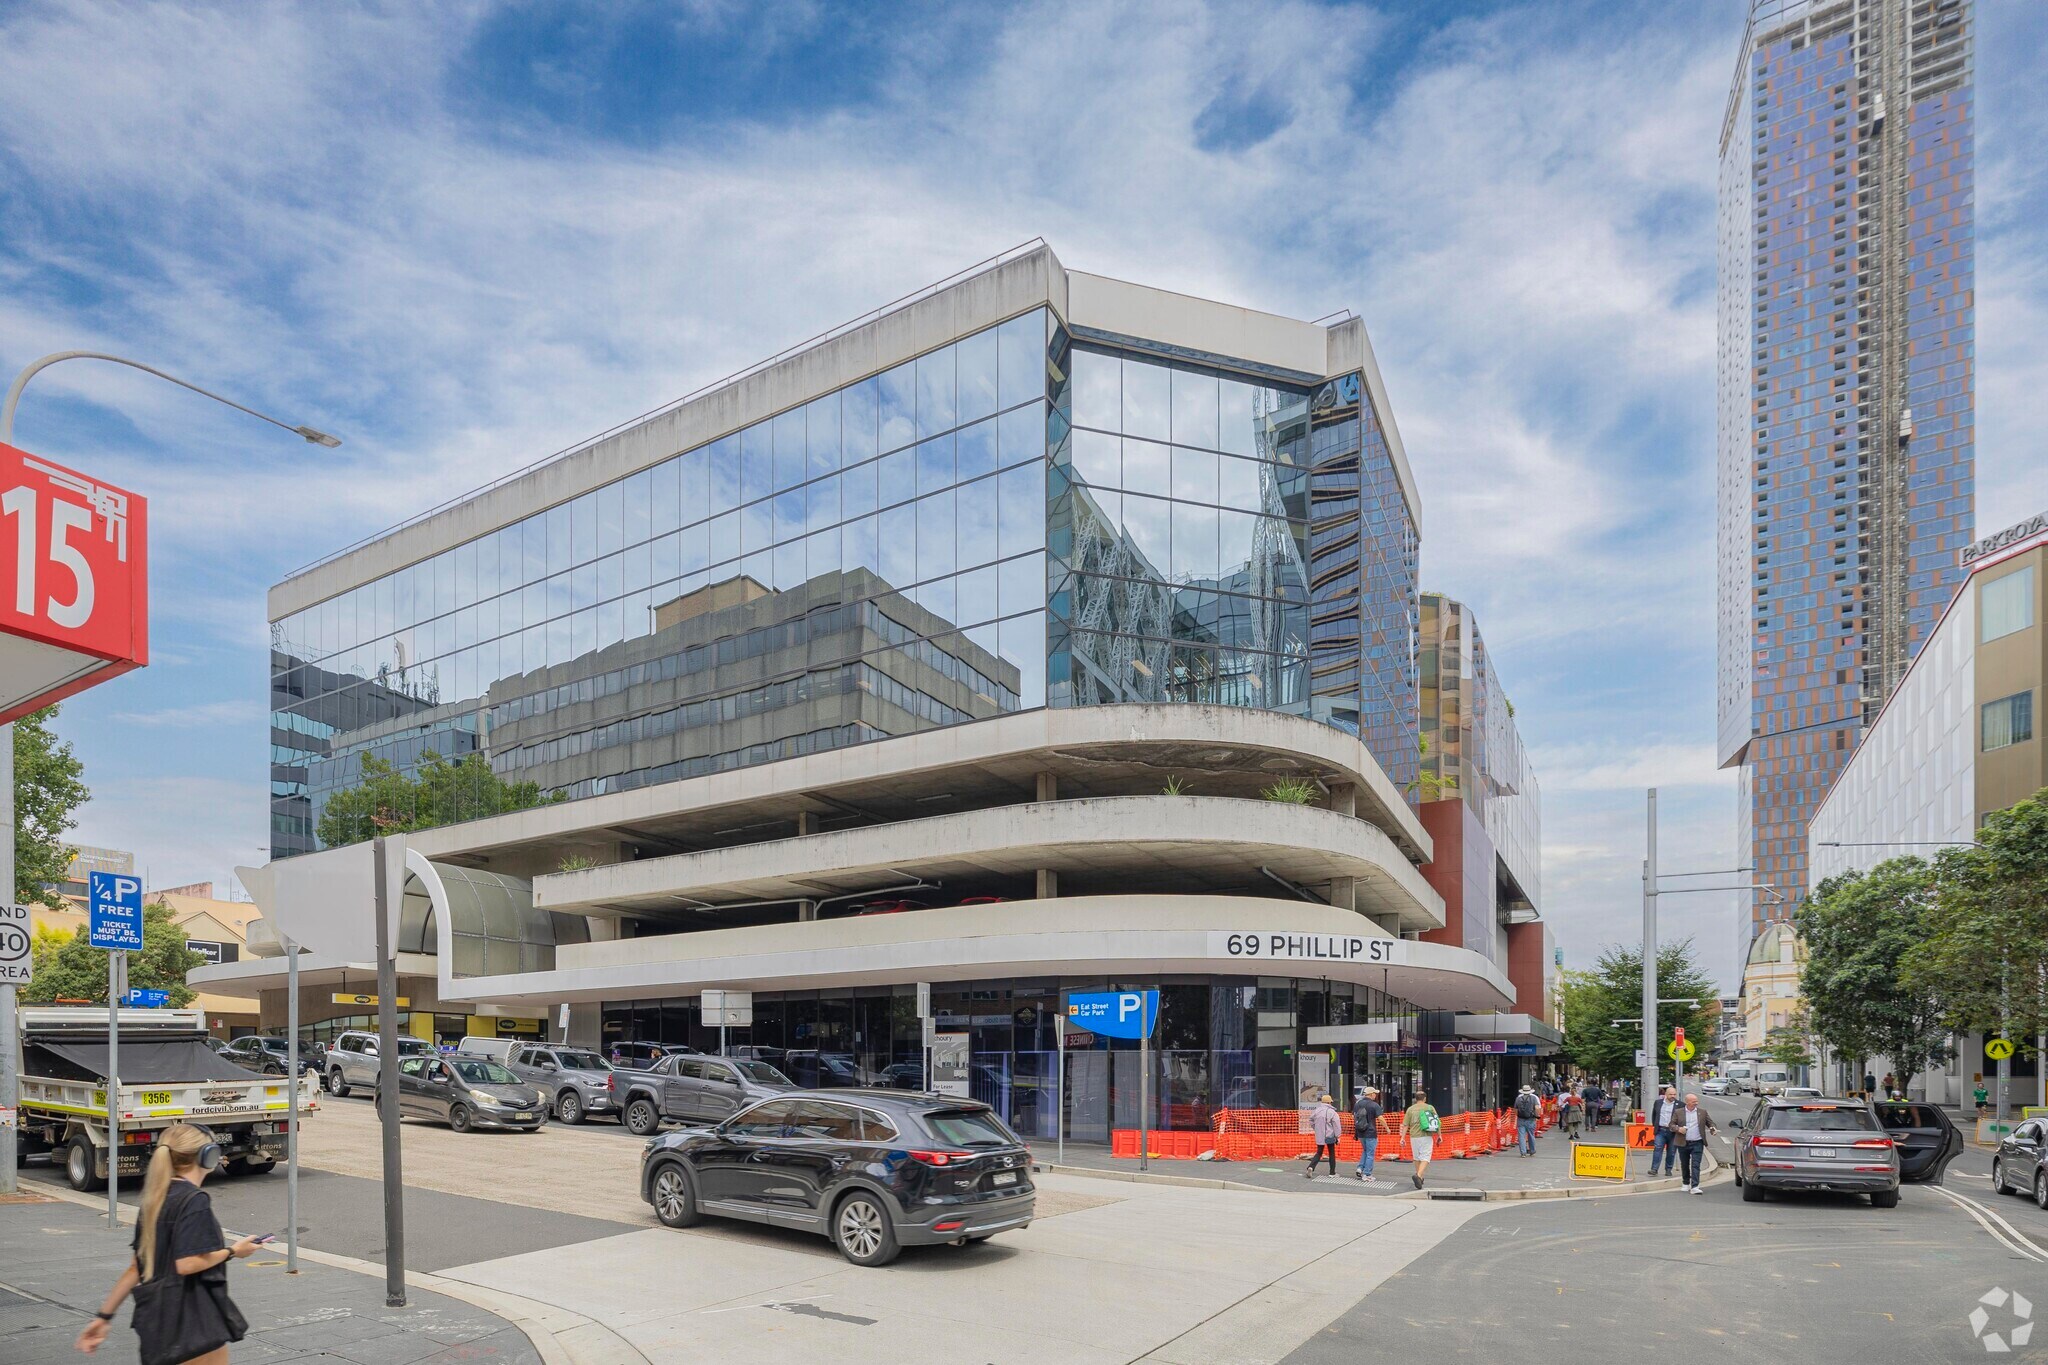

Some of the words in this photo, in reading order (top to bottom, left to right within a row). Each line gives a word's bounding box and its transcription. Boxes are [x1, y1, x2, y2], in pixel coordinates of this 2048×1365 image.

[1961, 514, 2048, 564] PARKROYA
[1, 485, 95, 628] 15
[115, 878, 138, 903] P
[0, 906, 26, 919] ND
[99, 904, 134, 917] FREE
[102, 920, 131, 929] TICKET
[92, 933, 140, 944] DISPLAYED
[98, 927, 121, 935] MUST
[124, 929, 136, 937] BE
[1227, 934, 1260, 956] 69
[1270, 935, 1363, 959] PHILLIP
[1370, 939, 1394, 962] ST
[0, 965, 30, 978] REA
[130, 990, 142, 1001] P
[1120, 993, 1141, 1023] P
[1457, 1042, 1492, 1052] Aussie
[192, 1103, 259, 1114] fordcivil.com.au
[1580, 1152, 1620, 1160] ROADWORK
